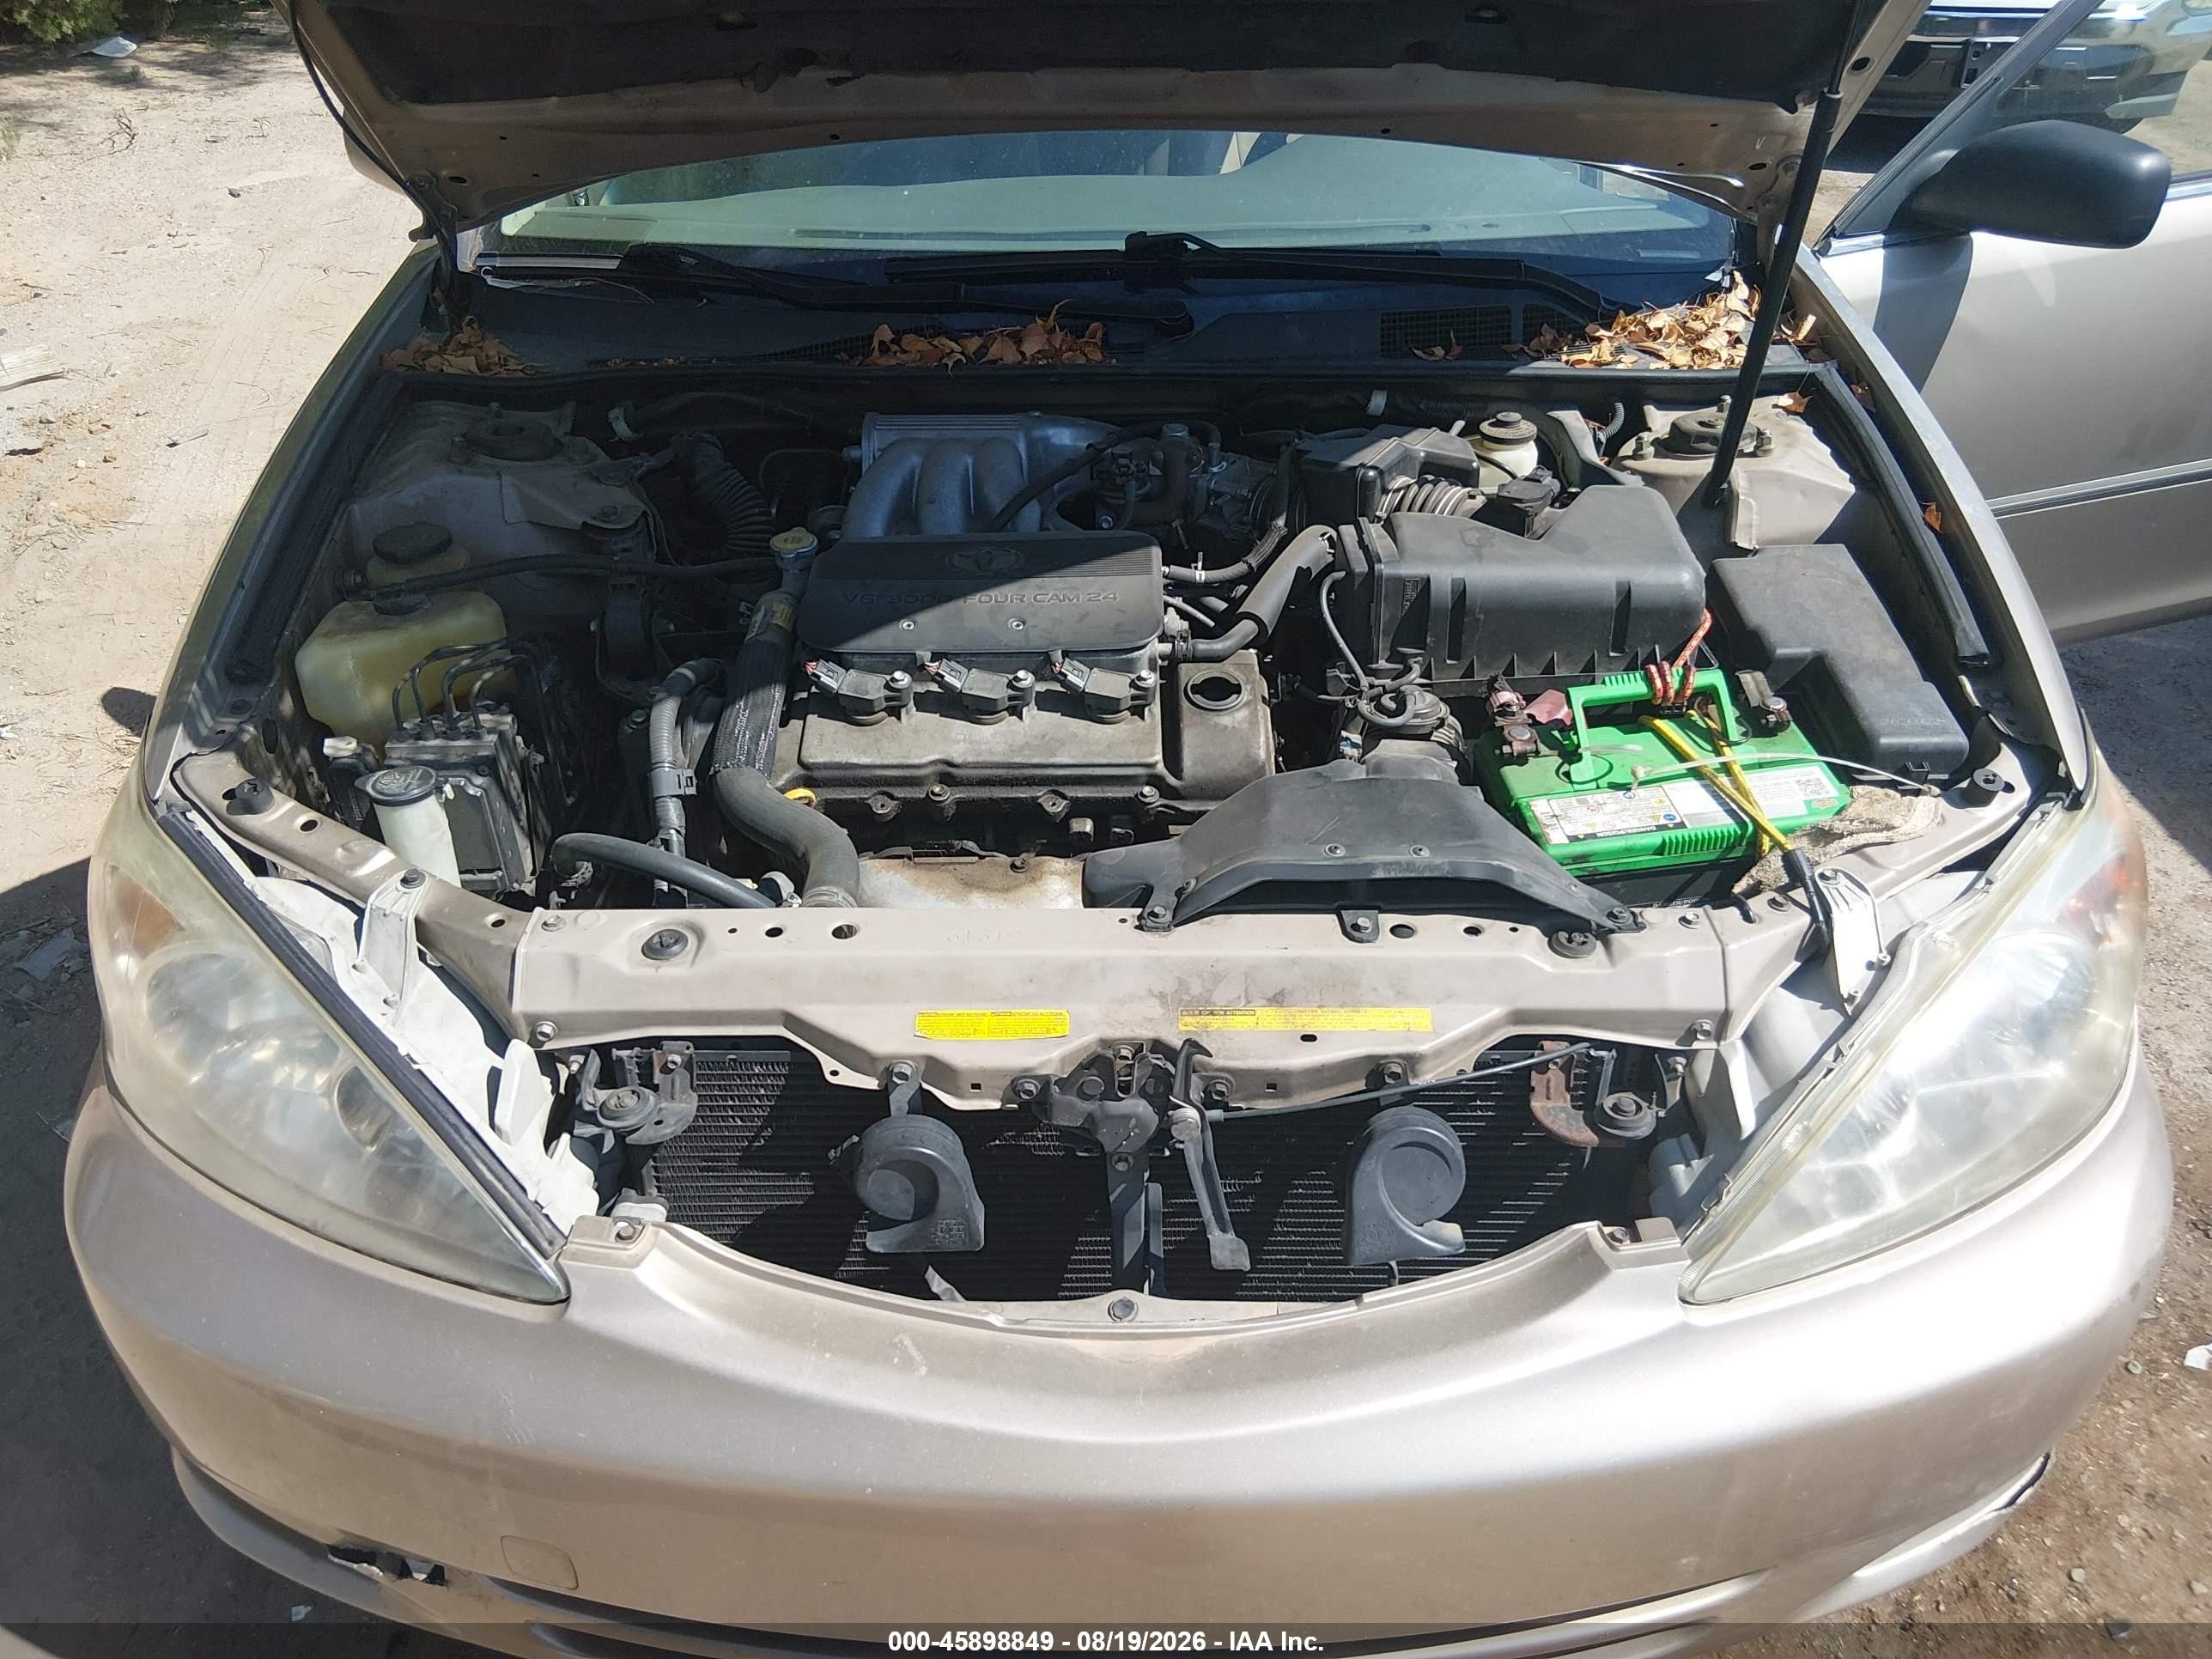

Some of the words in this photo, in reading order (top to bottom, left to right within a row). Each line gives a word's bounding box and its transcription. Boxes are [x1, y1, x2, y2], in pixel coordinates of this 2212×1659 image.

[842, 592, 880, 605] V6
[963, 592, 1025, 605] FOUR
[1031, 592, 1081, 604] CAM
[1085, 591, 1120, 603] 24
